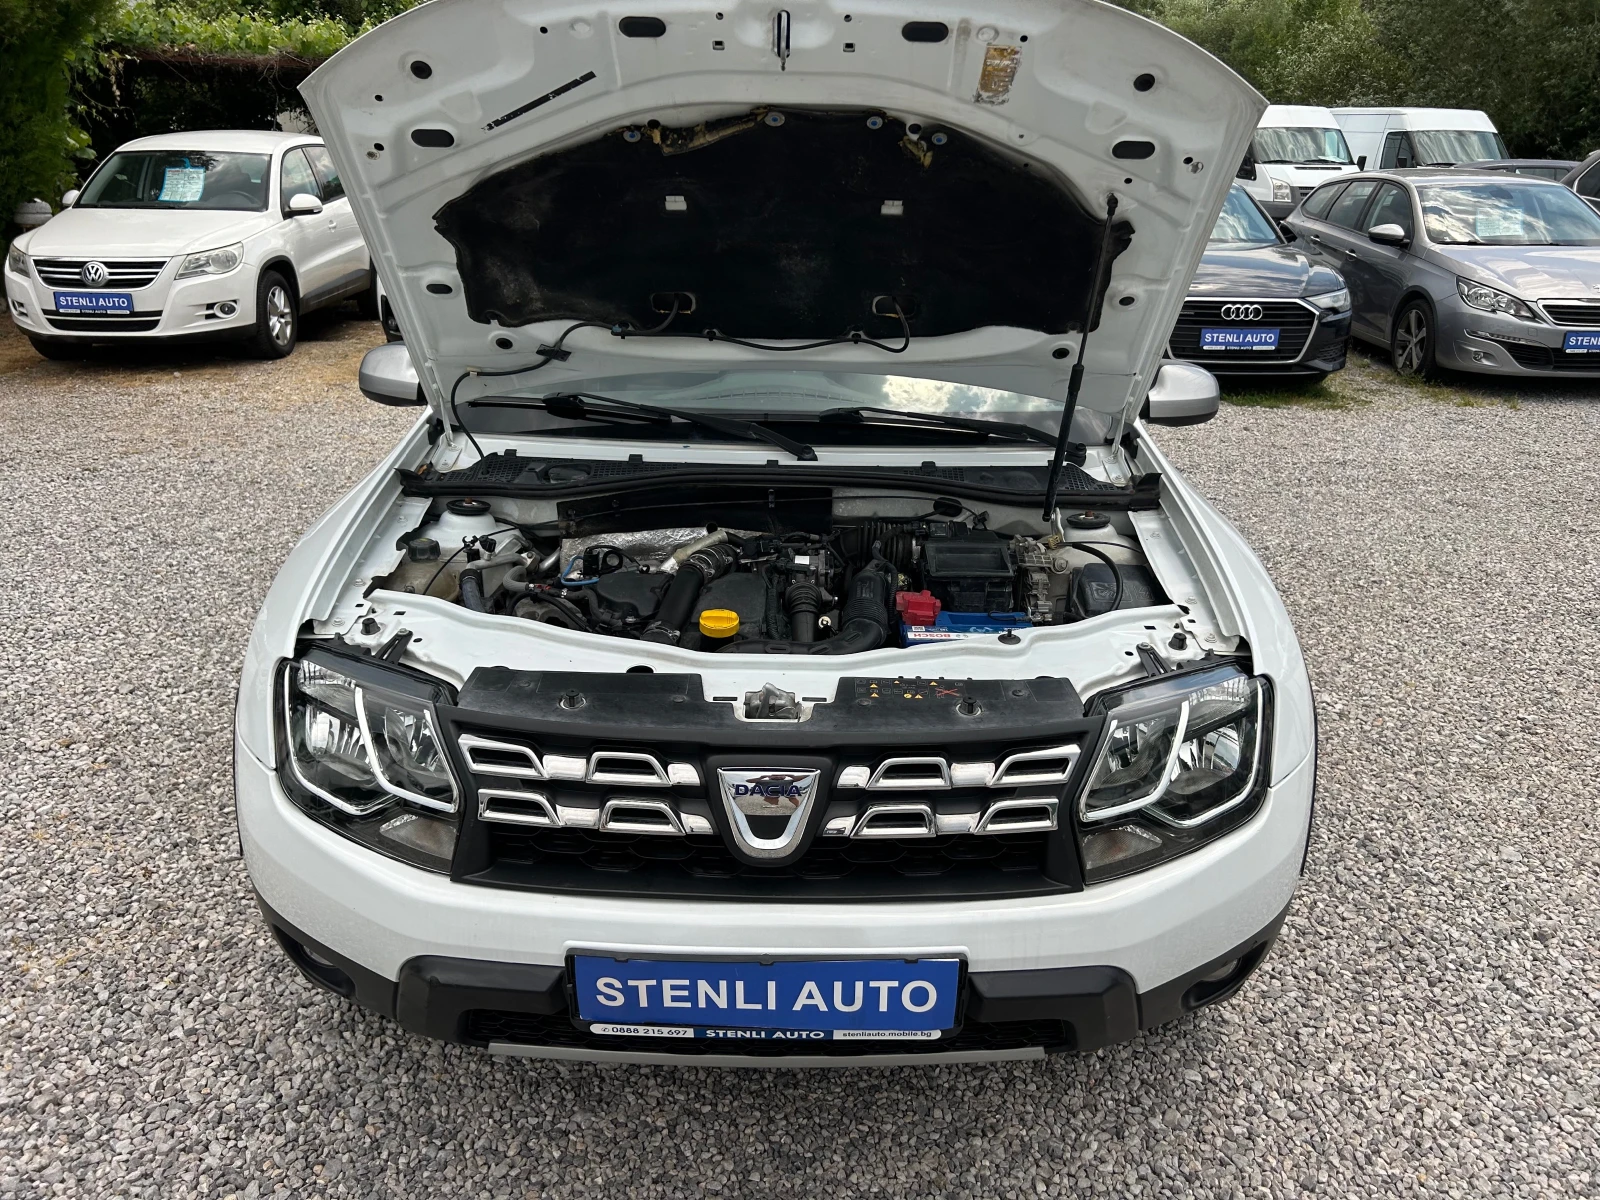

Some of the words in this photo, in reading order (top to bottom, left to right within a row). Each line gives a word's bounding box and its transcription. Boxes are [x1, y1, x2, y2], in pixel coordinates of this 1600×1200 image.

[59, 296, 96, 306] STENLI
[98, 298, 128, 307] AUTO
[1204, 333, 1243, 343] STENLI
[1244, 333, 1275, 343] AUTO
[734, 783, 802, 797] DACIA
[595, 976, 776, 1010] STENLI
[791, 979, 937, 1013] AUTO
[611, 1025, 639, 1035] 0888
[642, 1027, 664, 1036] 215
[666, 1028, 688, 1037] 697
[705, 1029, 767, 1038] STENLI
[772, 1030, 825, 1039] AUTO
[841, 1029, 932, 1039] stenliauto.mobile.bg
